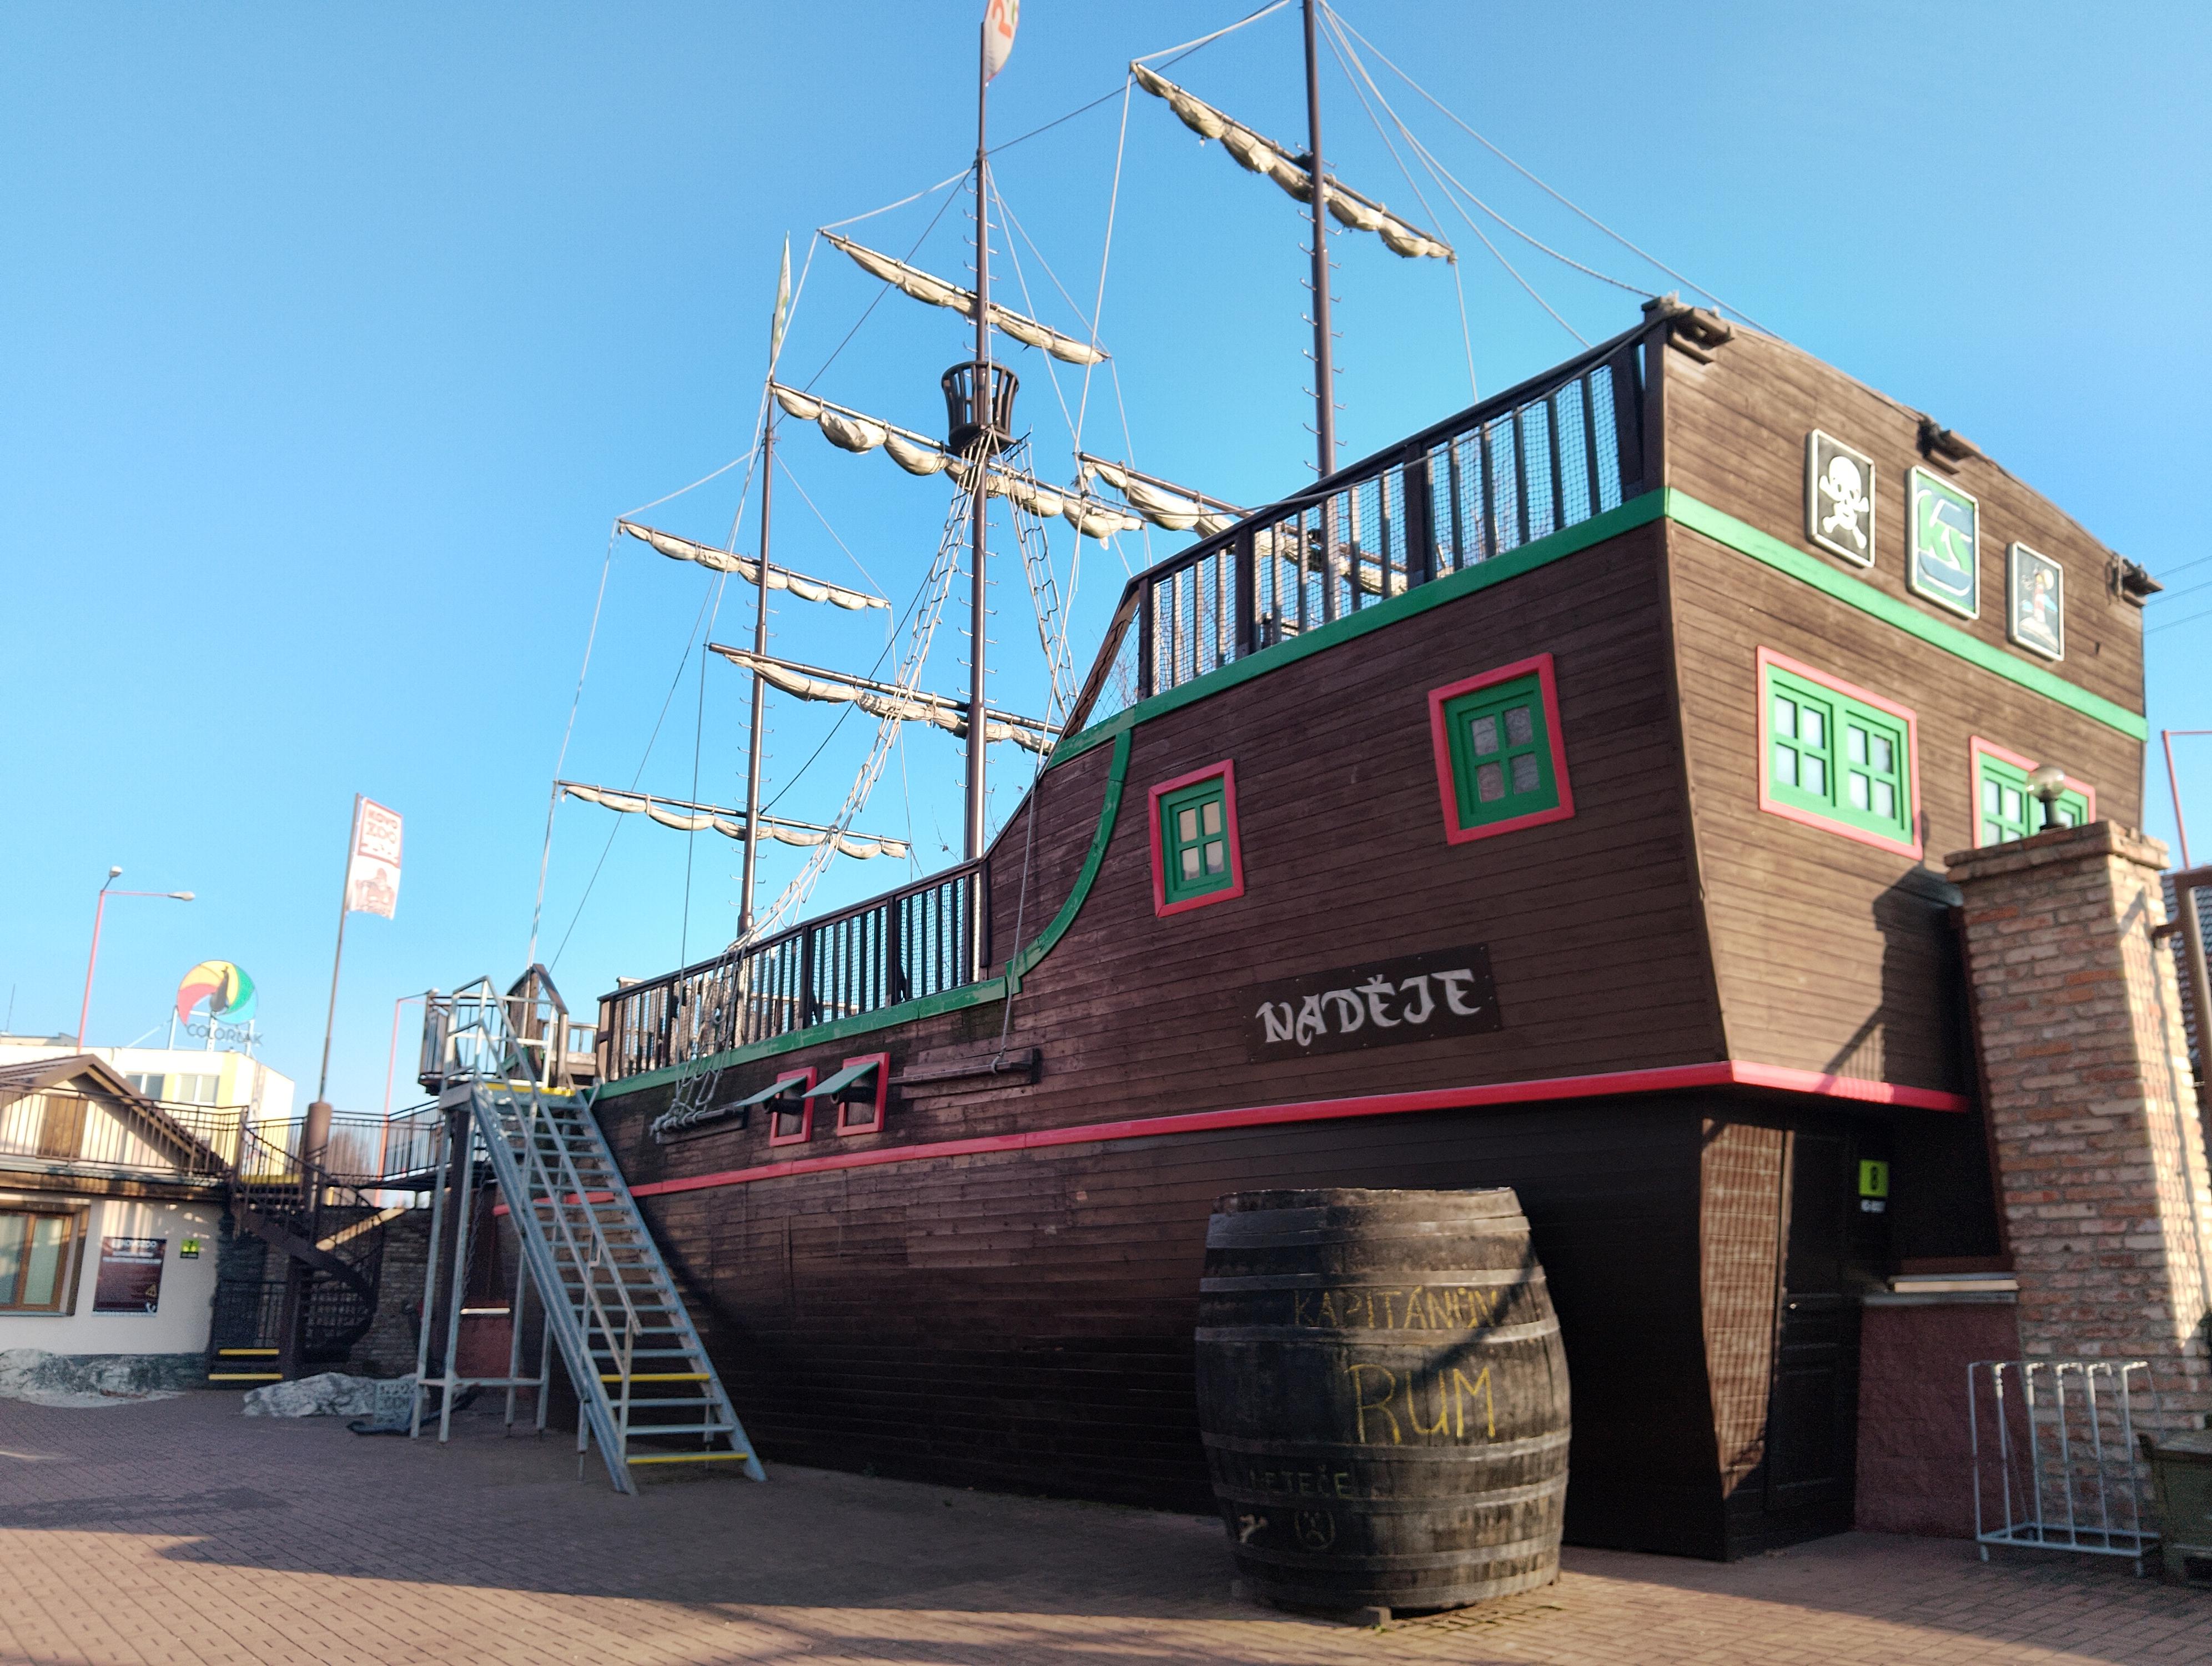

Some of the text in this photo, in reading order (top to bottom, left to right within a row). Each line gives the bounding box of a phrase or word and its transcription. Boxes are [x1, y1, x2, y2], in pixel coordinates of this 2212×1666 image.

[365, 821, 397, 844] ZOO
[1255, 969, 1481, 1046] NADĚJE
[1344, 1363, 1496, 1445] RUM
